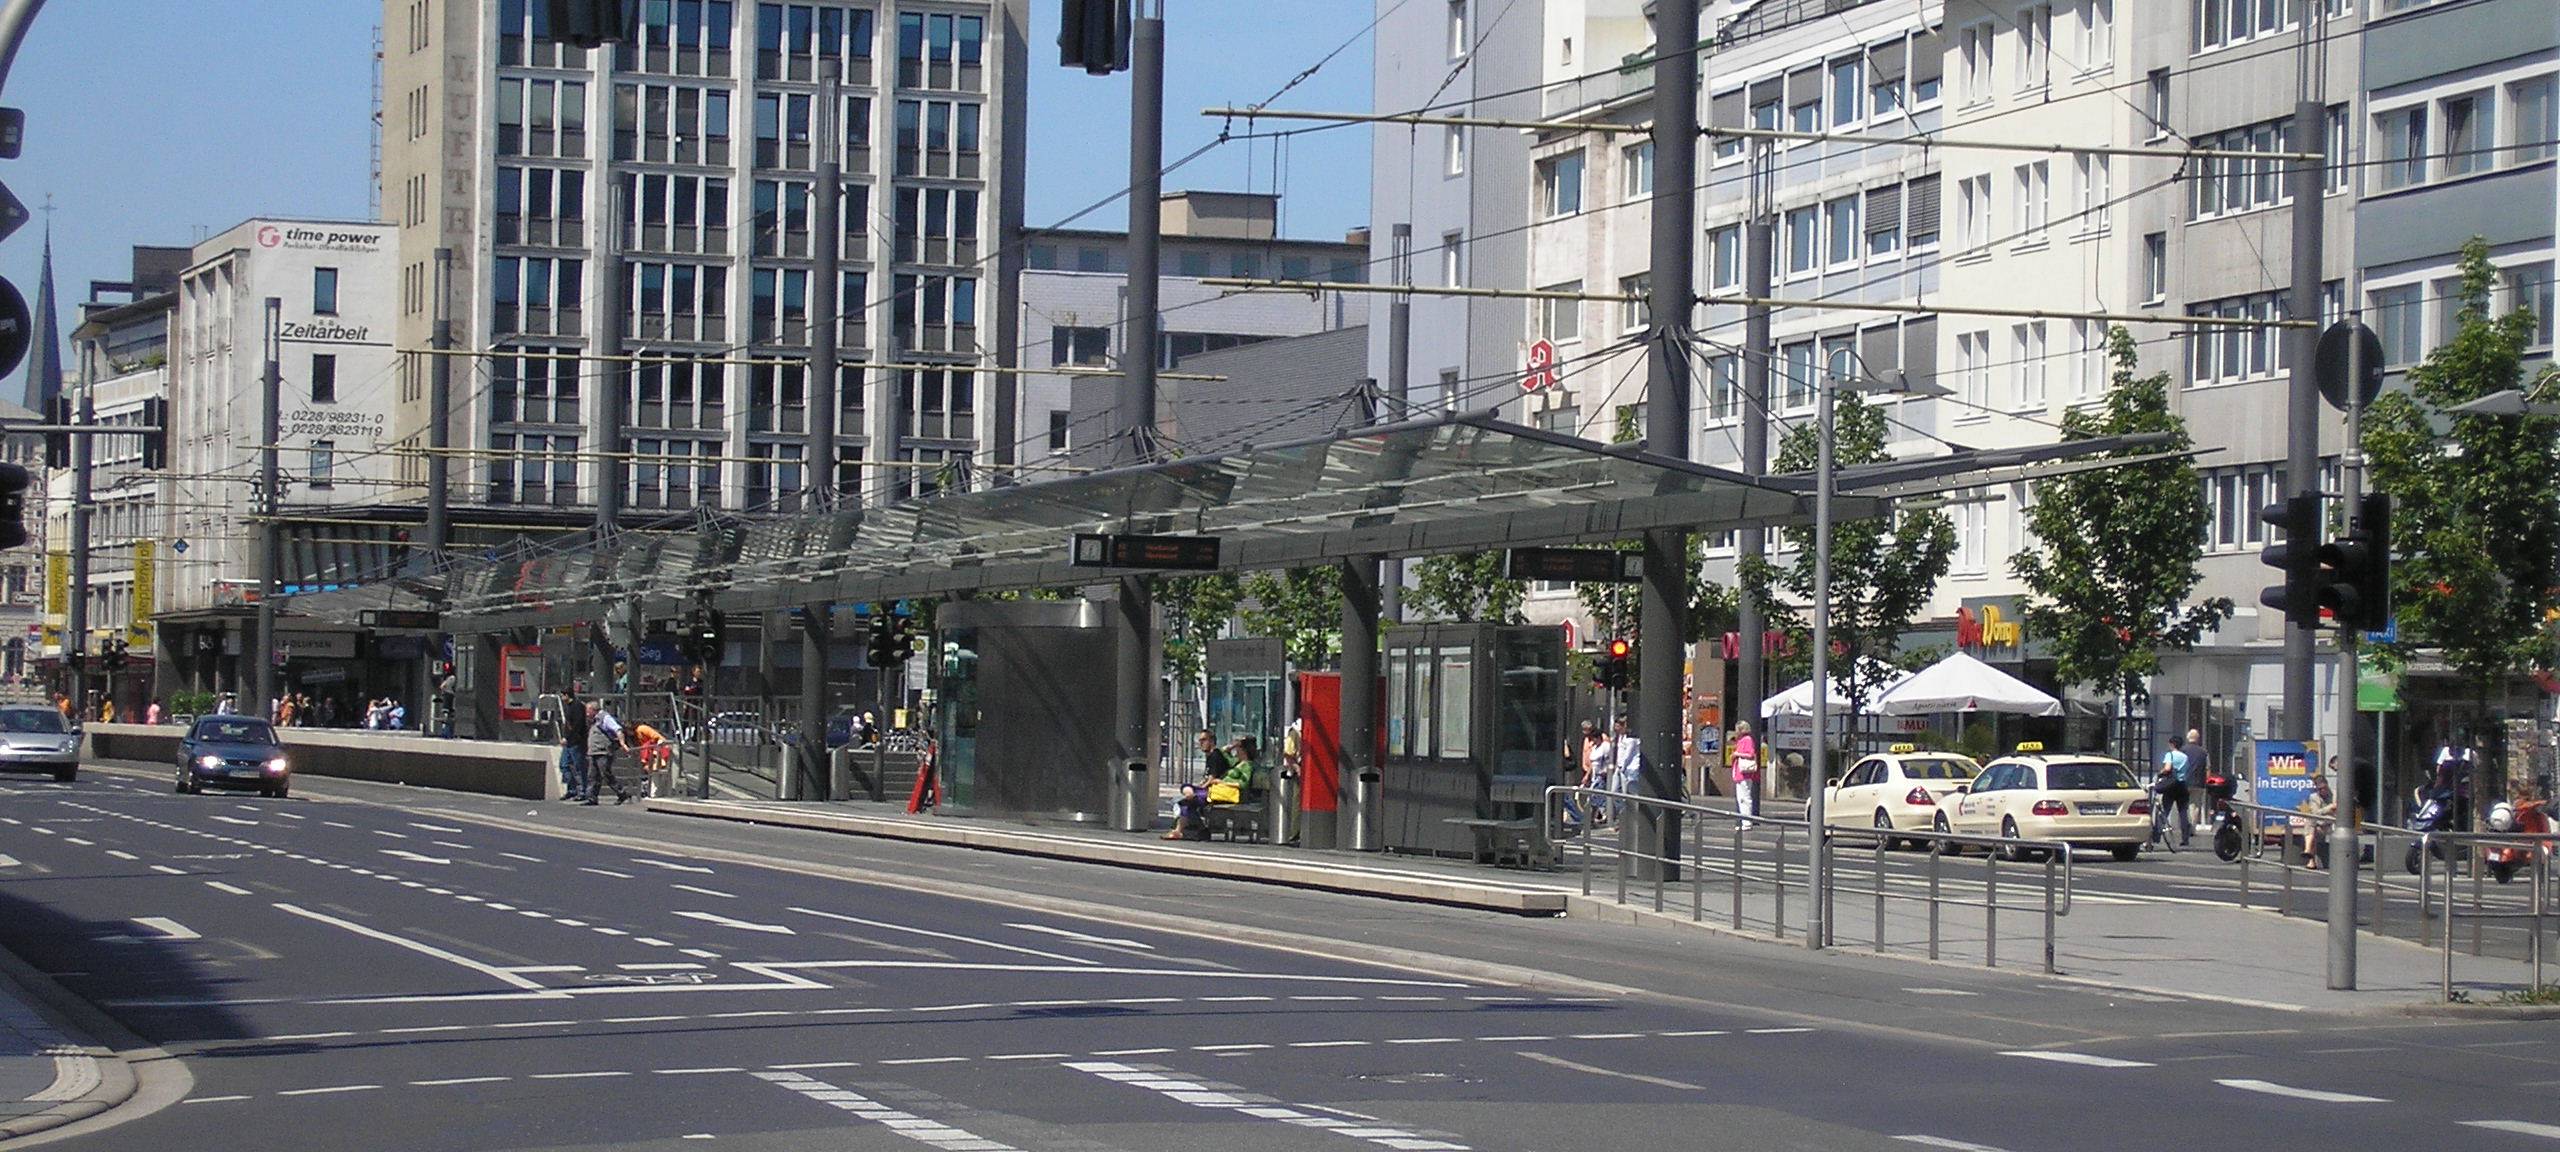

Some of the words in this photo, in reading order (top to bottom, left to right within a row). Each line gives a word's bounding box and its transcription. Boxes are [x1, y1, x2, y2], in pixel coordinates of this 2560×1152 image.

[286, 228, 324, 241] time
[327, 232, 381, 244] power
[280, 322, 369, 341] Zeitarbeit
[2271, 755, 2303, 769] Wir
[2257, 777, 2269, 789] in
[2270, 777, 2317, 792] Europa.
